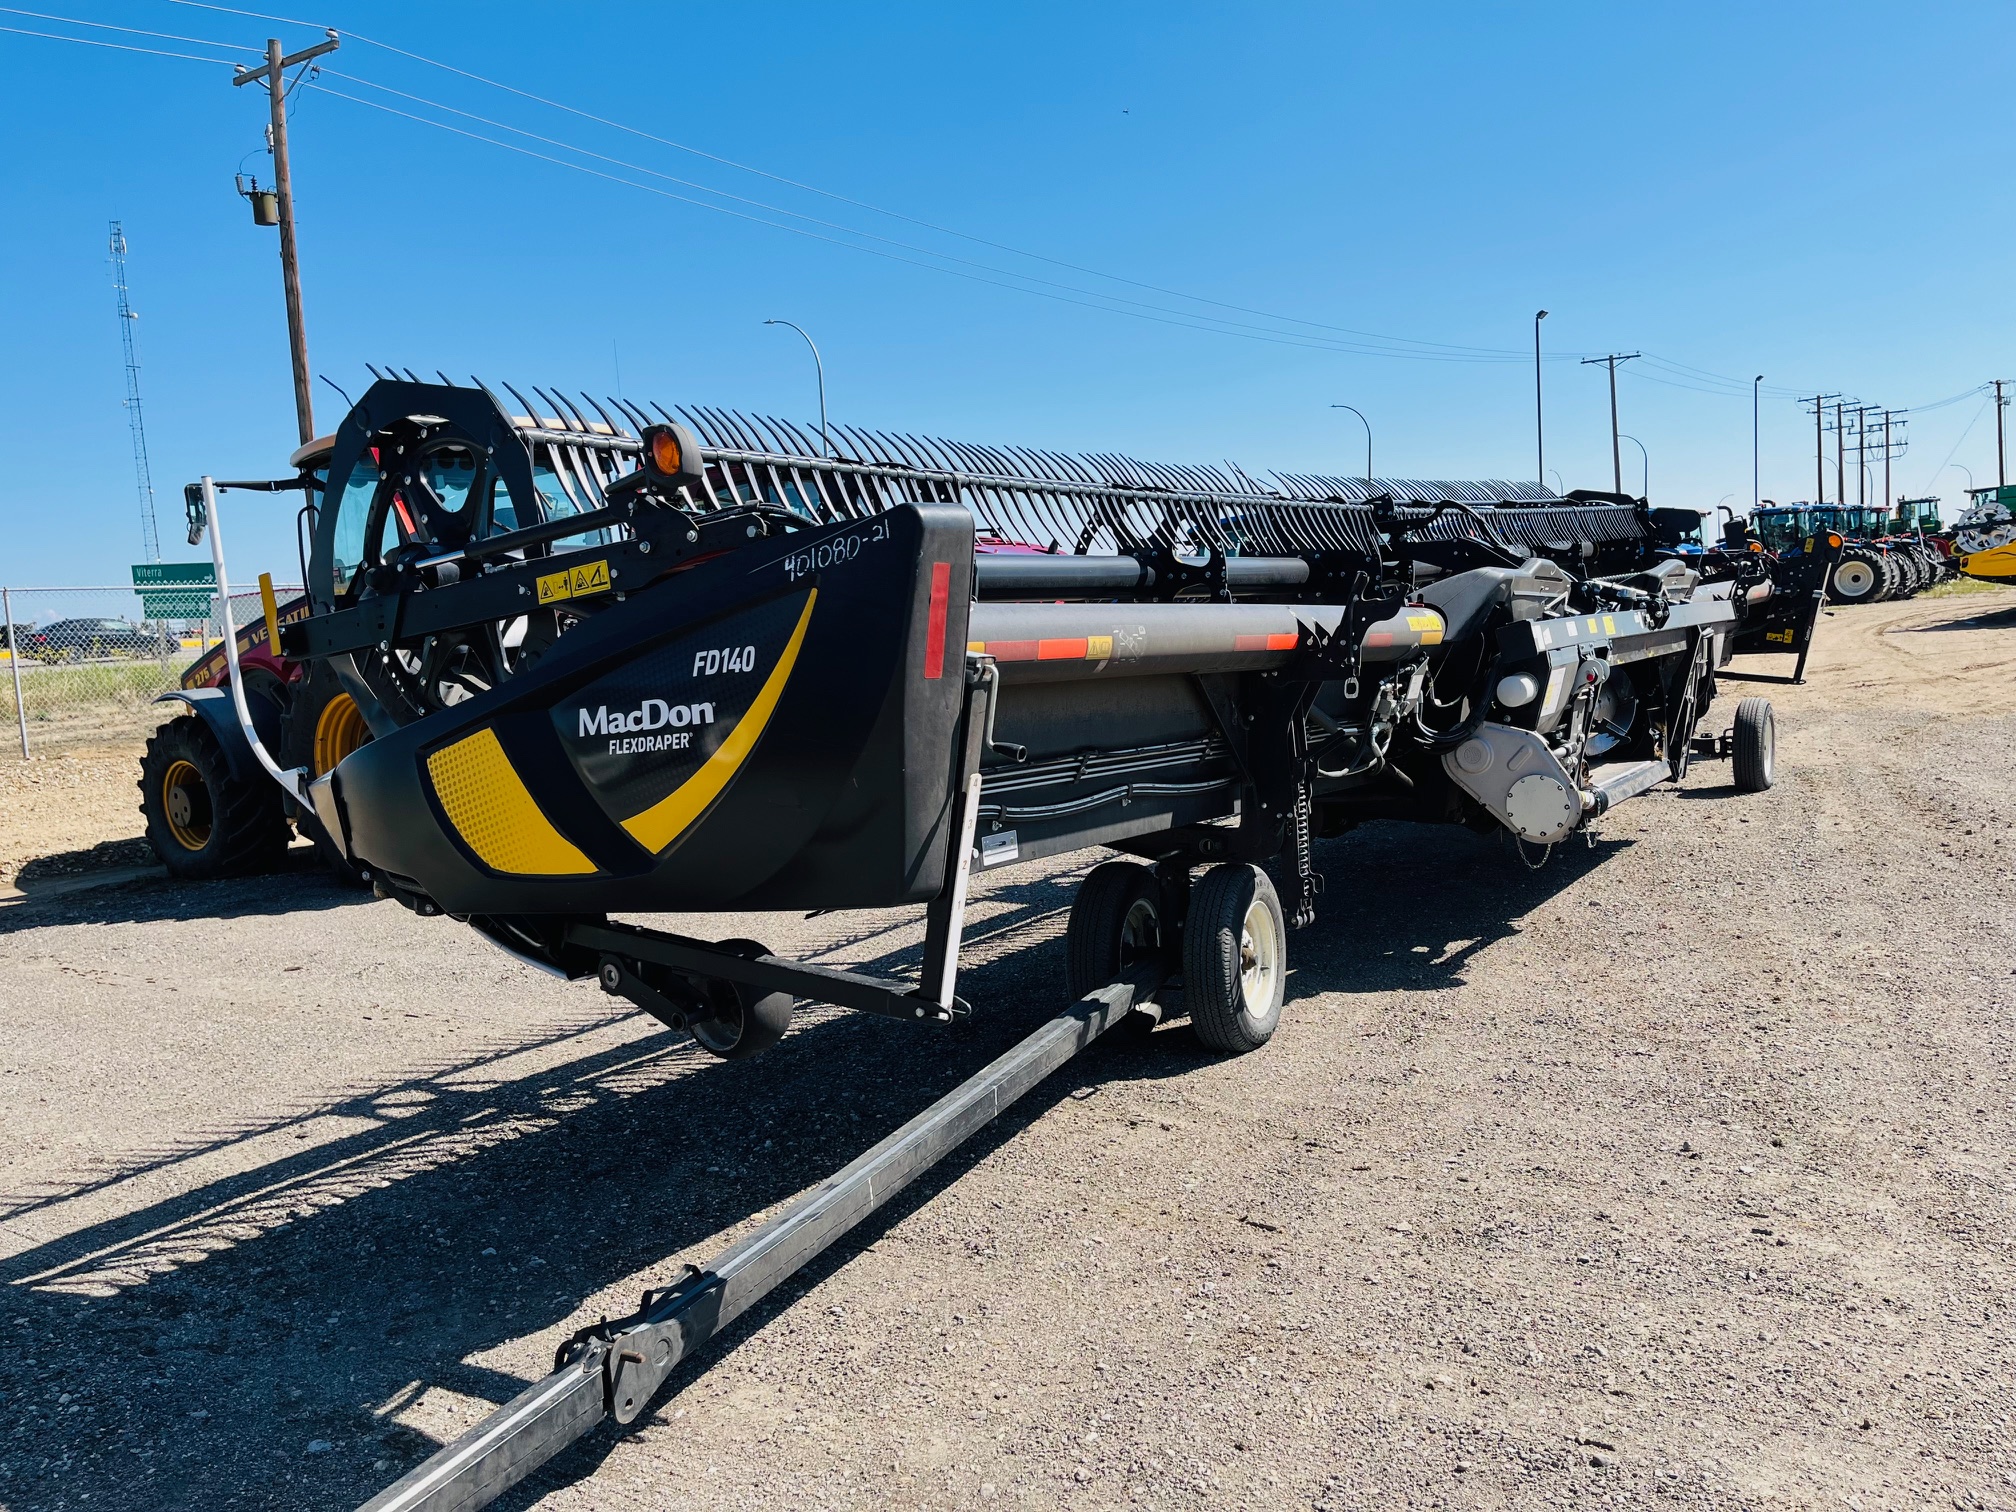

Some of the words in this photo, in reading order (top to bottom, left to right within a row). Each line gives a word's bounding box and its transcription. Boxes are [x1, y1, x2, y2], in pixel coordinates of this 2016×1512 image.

[784, 518, 890, 582] 401080-21
[136, 567, 162, 578] Viterra
[251, 605, 310, 645] VESATI
[692, 645, 756, 678] FD140
[195, 666, 210, 687] 275
[578, 698, 715, 738] MacDon
[608, 732, 690, 756] FLEXDRAPER
[967, 818, 973, 830] 3
[961, 859, 968, 870] 2
